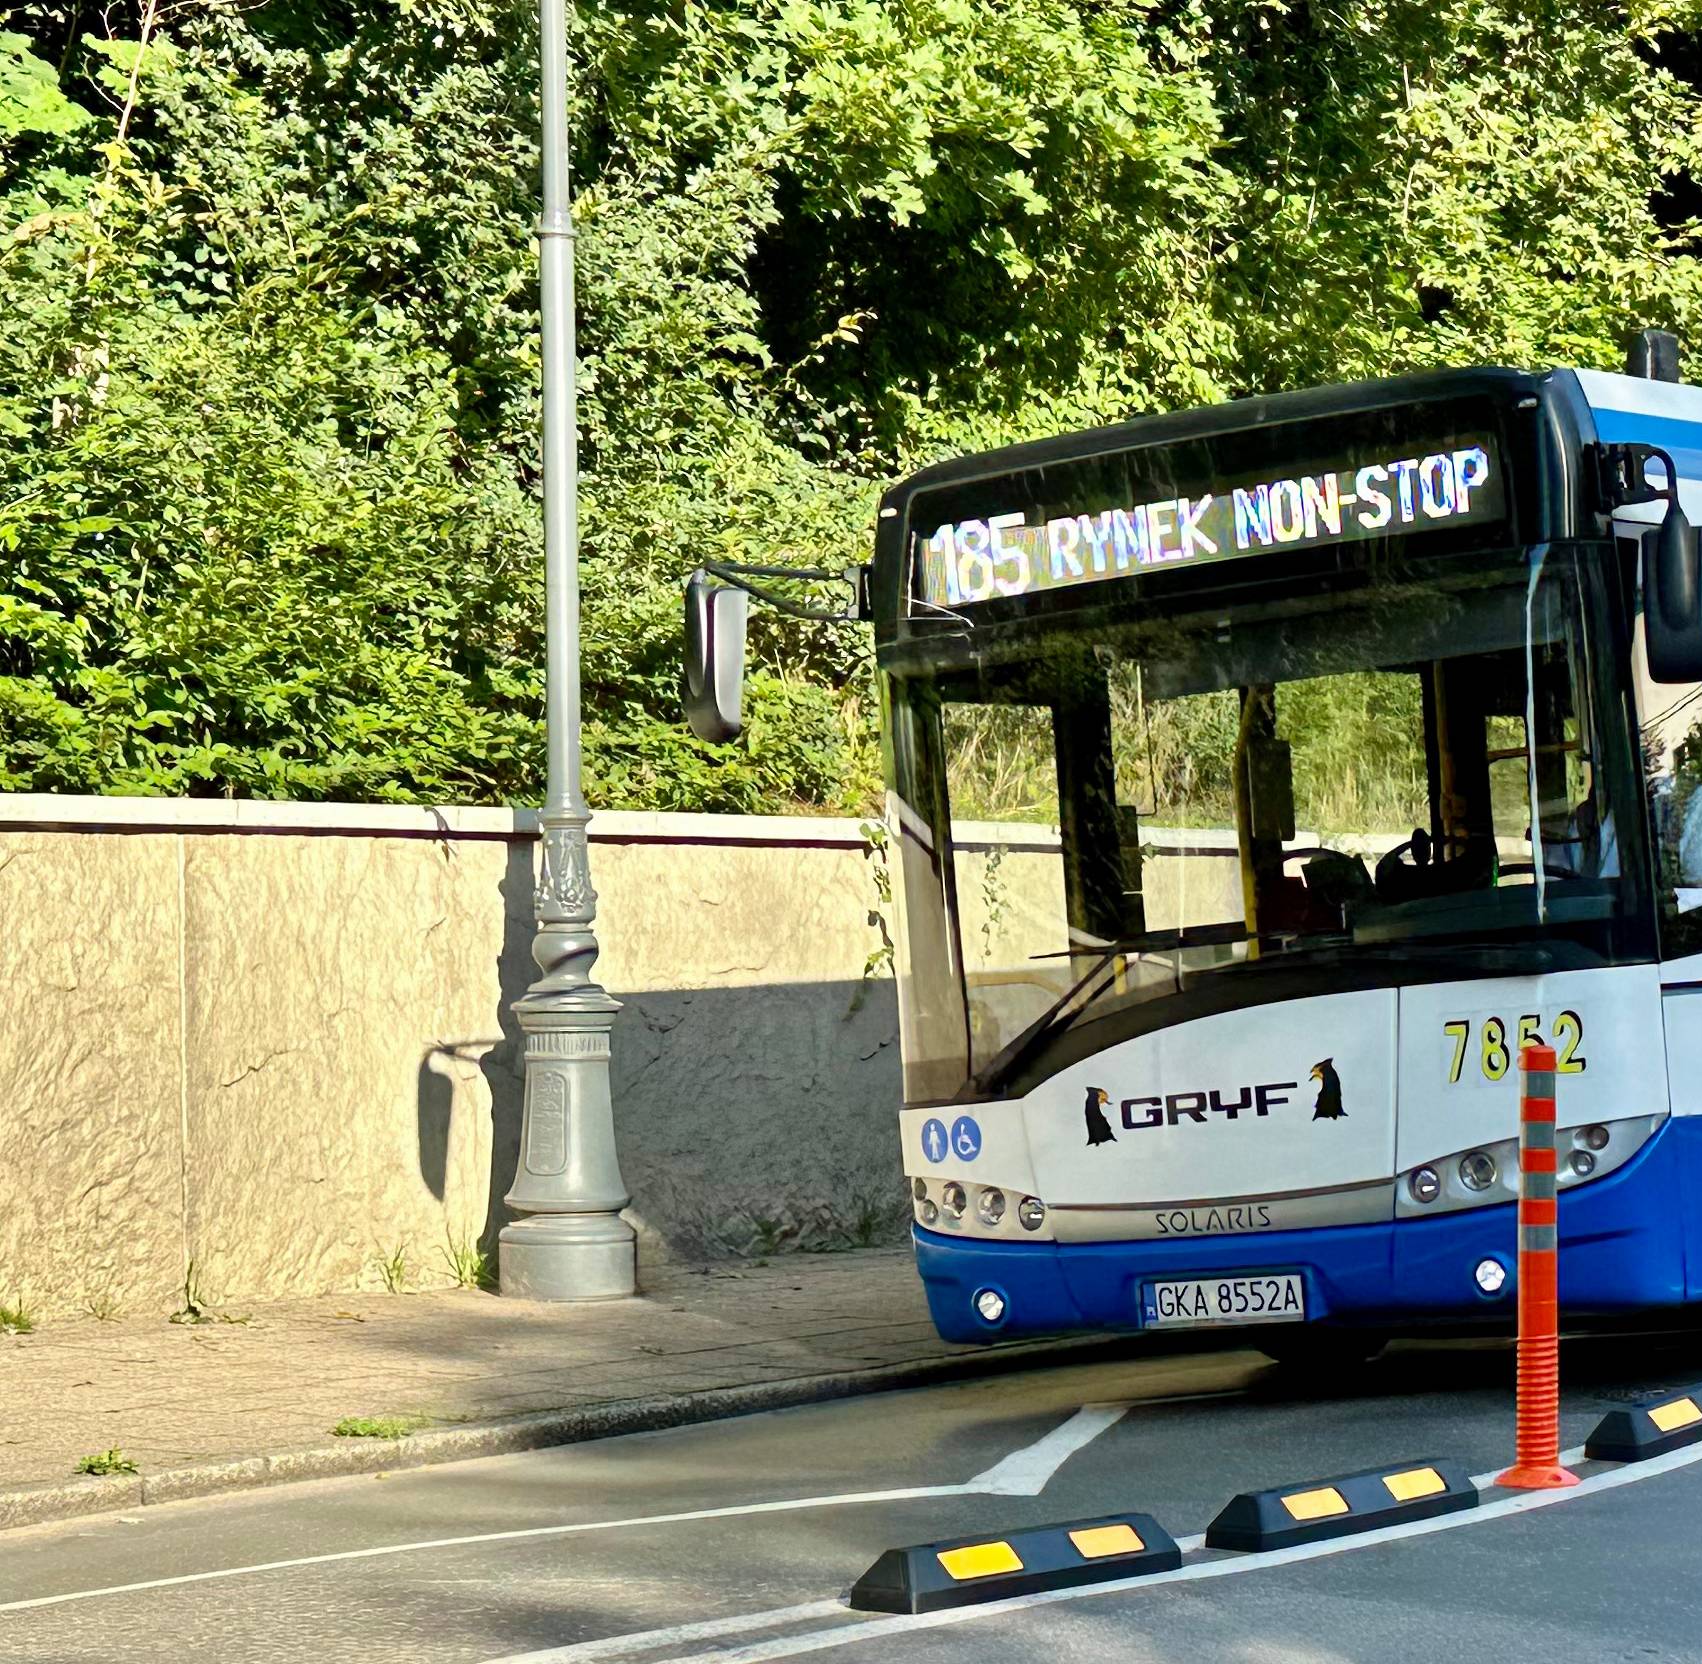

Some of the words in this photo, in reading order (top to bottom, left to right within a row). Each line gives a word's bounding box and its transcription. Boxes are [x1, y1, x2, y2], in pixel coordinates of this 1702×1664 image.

[930, 512, 1031, 605] 185
[1047, 493, 1218, 580] RYNEK
[1233, 446, 1489, 549] NON-STOP
[1444, 1010, 1586, 1083] 7852
[1121, 1082, 1297, 1129] GRYF
[1156, 1206, 1271, 1233] SOLARIS
[1158, 1284, 1209, 1317] GKA
[1217, 1279, 1299, 1314] 8552A
